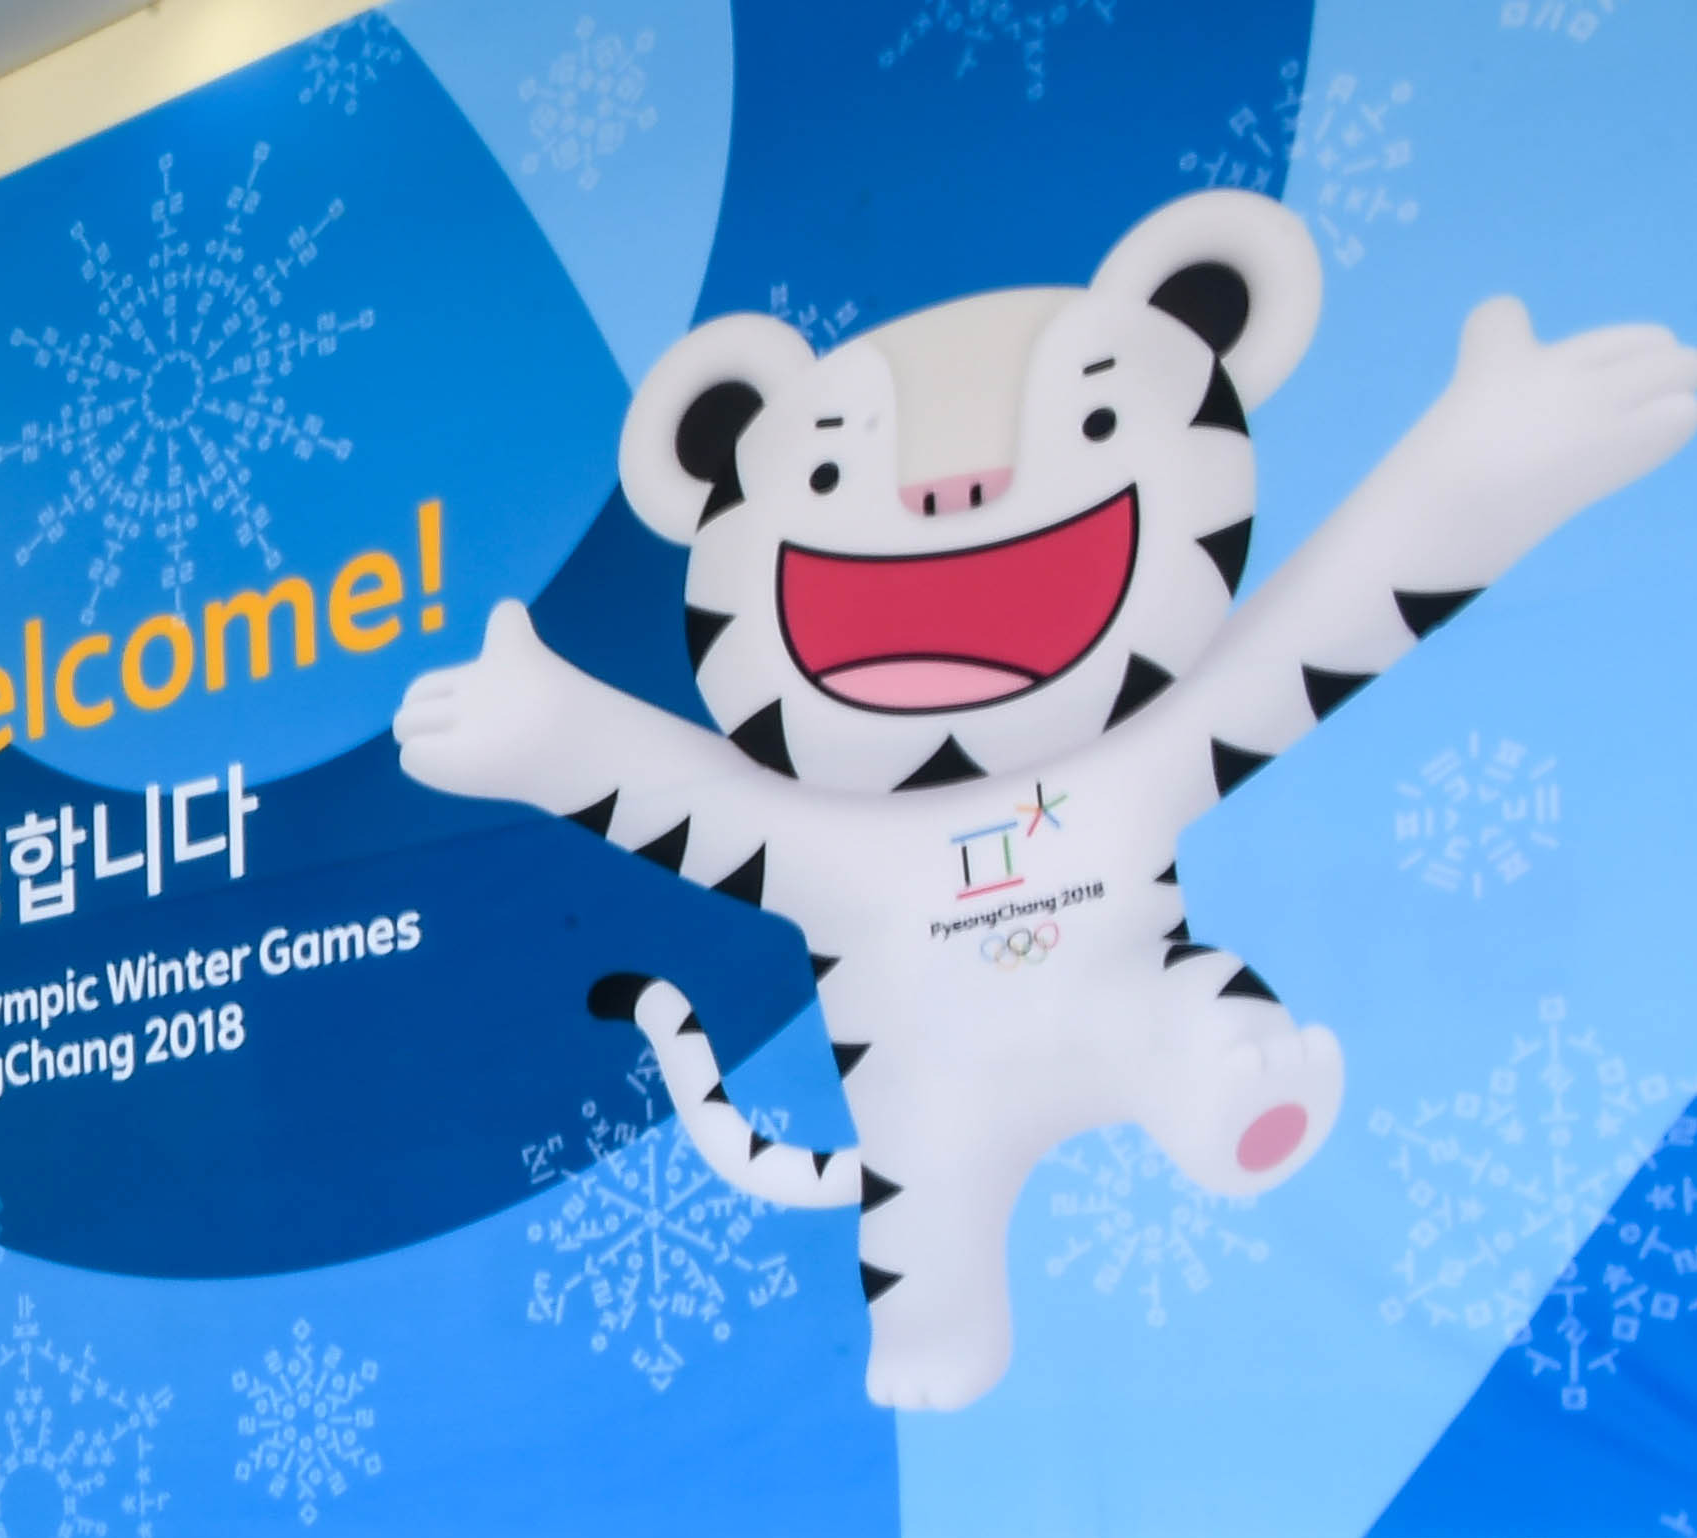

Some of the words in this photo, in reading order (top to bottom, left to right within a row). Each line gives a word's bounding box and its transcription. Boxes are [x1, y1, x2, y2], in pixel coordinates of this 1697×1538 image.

[1061, 882, 1105, 907] 2018
[107, 943, 251, 1004] Winter
[260, 910, 422, 976] Games
[145, 1003, 245, 1064] 2018
